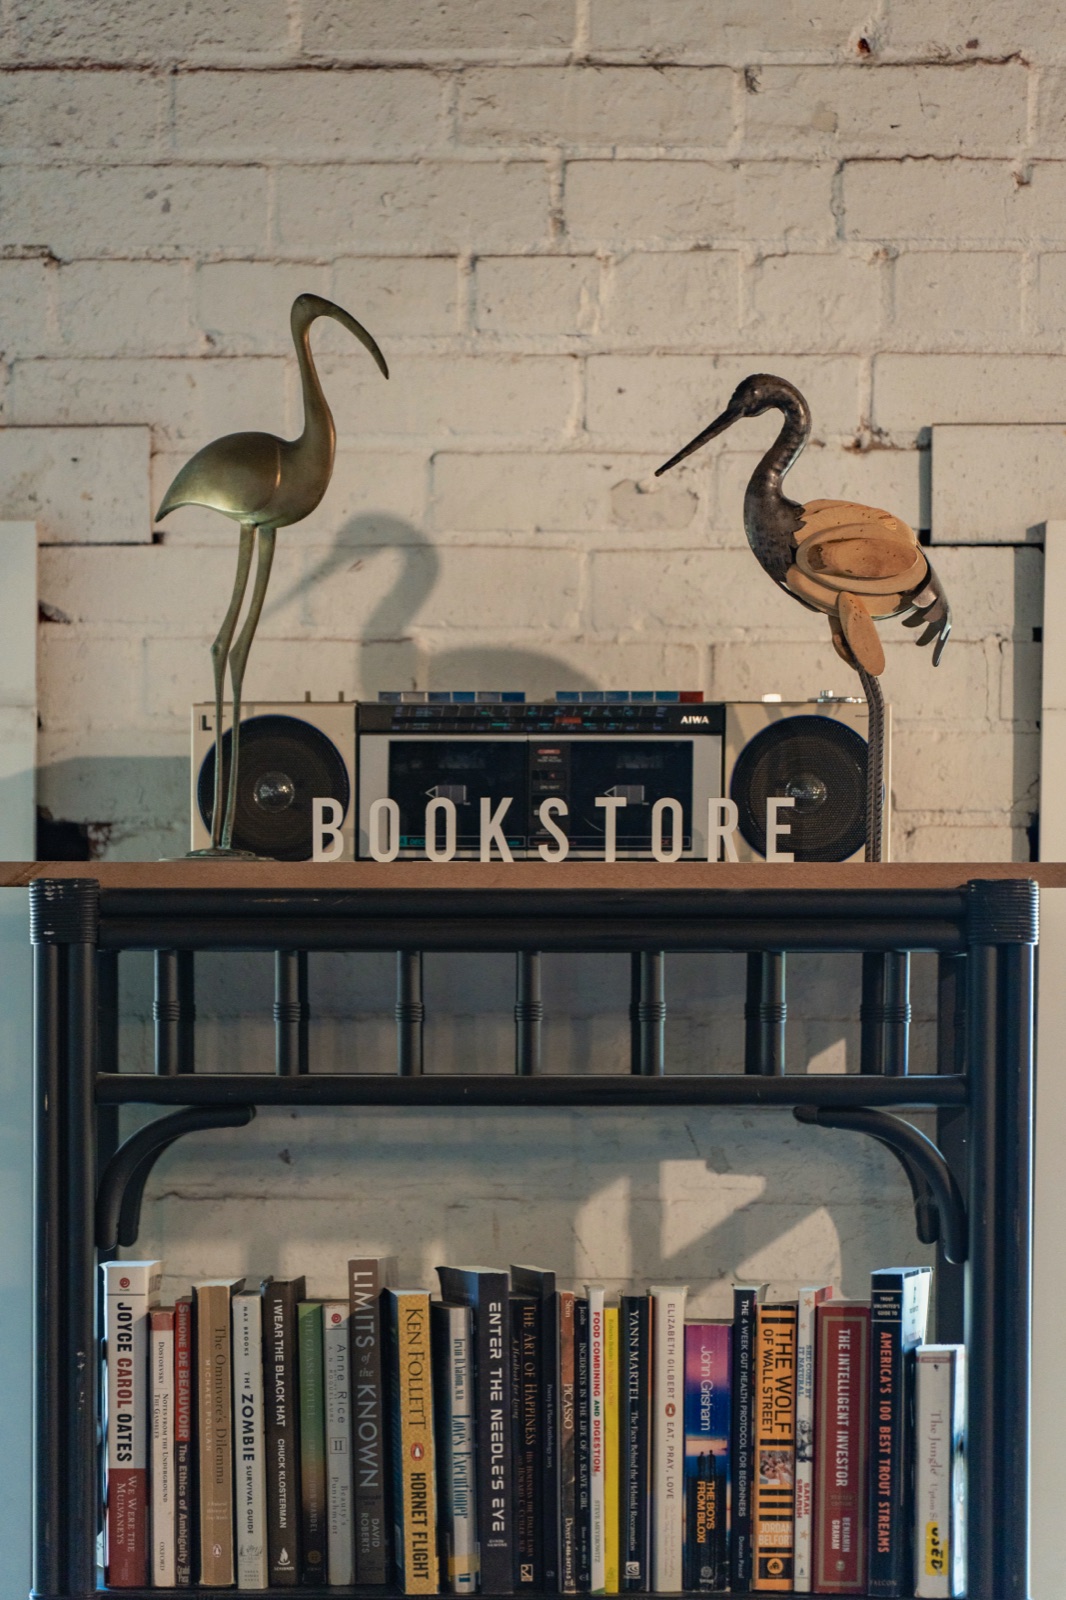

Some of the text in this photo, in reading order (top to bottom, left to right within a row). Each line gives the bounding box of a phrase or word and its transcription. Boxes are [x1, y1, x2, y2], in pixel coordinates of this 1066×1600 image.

[680, 715, 709, 724] AIWA
[312, 796, 796, 863] BOOKSTORE
[117, 1303, 132, 1352] JOYCE
[354, 1272, 375, 1347] LIMITS
[489, 1303, 502, 1358] ENTER
[578, 1306, 586, 1325] Jacobs
[741, 1300, 749, 1315] THE
[361, 1352, 371, 1365] of
[454, 1338, 466, 1356] Irvin
[629, 1311, 639, 1403] YANN MARTEL
[798, 1346, 804, 1355] IT
[838, 1329, 850, 1350] THE
[117, 1358, 132, 1408] CAROL
[178, 1304, 189, 1438] SIMONE DE BEAUVOIR
[274, 1305, 285, 1427] WEAR THE BLACK HAT
[337, 1344, 347, 1423] Anne Rice
[359, 1368, 374, 1377] the
[406, 1309, 426, 1429] KEN FOLLETT
[490, 1368, 502, 1401] THE
[523, 1305, 537, 1445] THE ART OF HAPPINESS
[579, 1343, 587, 1385] INCIDENTS
[740, 1372, 748, 1403] HEALTH
[762, 1329, 773, 1433] OF WALL STREET
[775, 1329, 792, 1434] THE WOLF
[215, 1326, 227, 1484] The Omnivore's Dilemma
[563, 1383, 573, 1429] PICASSO
[580, 1389, 586, 1397] IN
[701, 1346, 713, 1430] John Grisham
[805, 1389, 811, 1399] BY
[836, 1354, 850, 1426] INTELLIGENT
[117, 1414, 132, 1461] OATES
[242, 1394, 254, 1461] ZOMBIE
[358, 1385, 378, 1486] KNOWN
[490, 1409, 504, 1490] NEEDLE'S
[580, 1440, 587, 1450] OF
[666, 1422, 674, 1442] EAT,
[878, 1332, 892, 1553] AMERICA'S 100 BEST TROUT STREAMS
[928, 1410, 943, 1475] The Jungle
[179, 1445, 187, 1462] The
[452, 1415, 472, 1518] Love's Executioner
[666, 1446, 674, 1473] PRAY,
[836, 1431, 848, 1486] INVESTOR
[178, 1466, 188, 1497] Ethics
[178, 1500, 188, 1510] of
[278, 1471, 286, 1528] KLOSTERMAN
[666, 1477, 674, 1499] LOVE
[707, 1481, 715, 1529] THE BOYS
[928, 1483, 938, 1510] Upton
[117, 1483, 126, 1544] MULVANEYS
[127, 1476, 137, 1552] WE WERE THE
[340, 1486, 348, 1526] Beauty's
[411, 1473, 428, 1579] HORNET FLIGHT
[492, 1498, 504, 1531] EYE
[697, 1481, 705, 1543] FROM BILOXI
[760, 1522, 791, 1534] JORDAN
[178, 1514, 189, 1563] Ambiguity
[361, 1513, 370, 1553] ROBERTS
[371, 1518, 380, 1547] DAVID
[831, 1520, 840, 1549] GRAHAM
[841, 1517, 850, 1552] BENJAMIN
